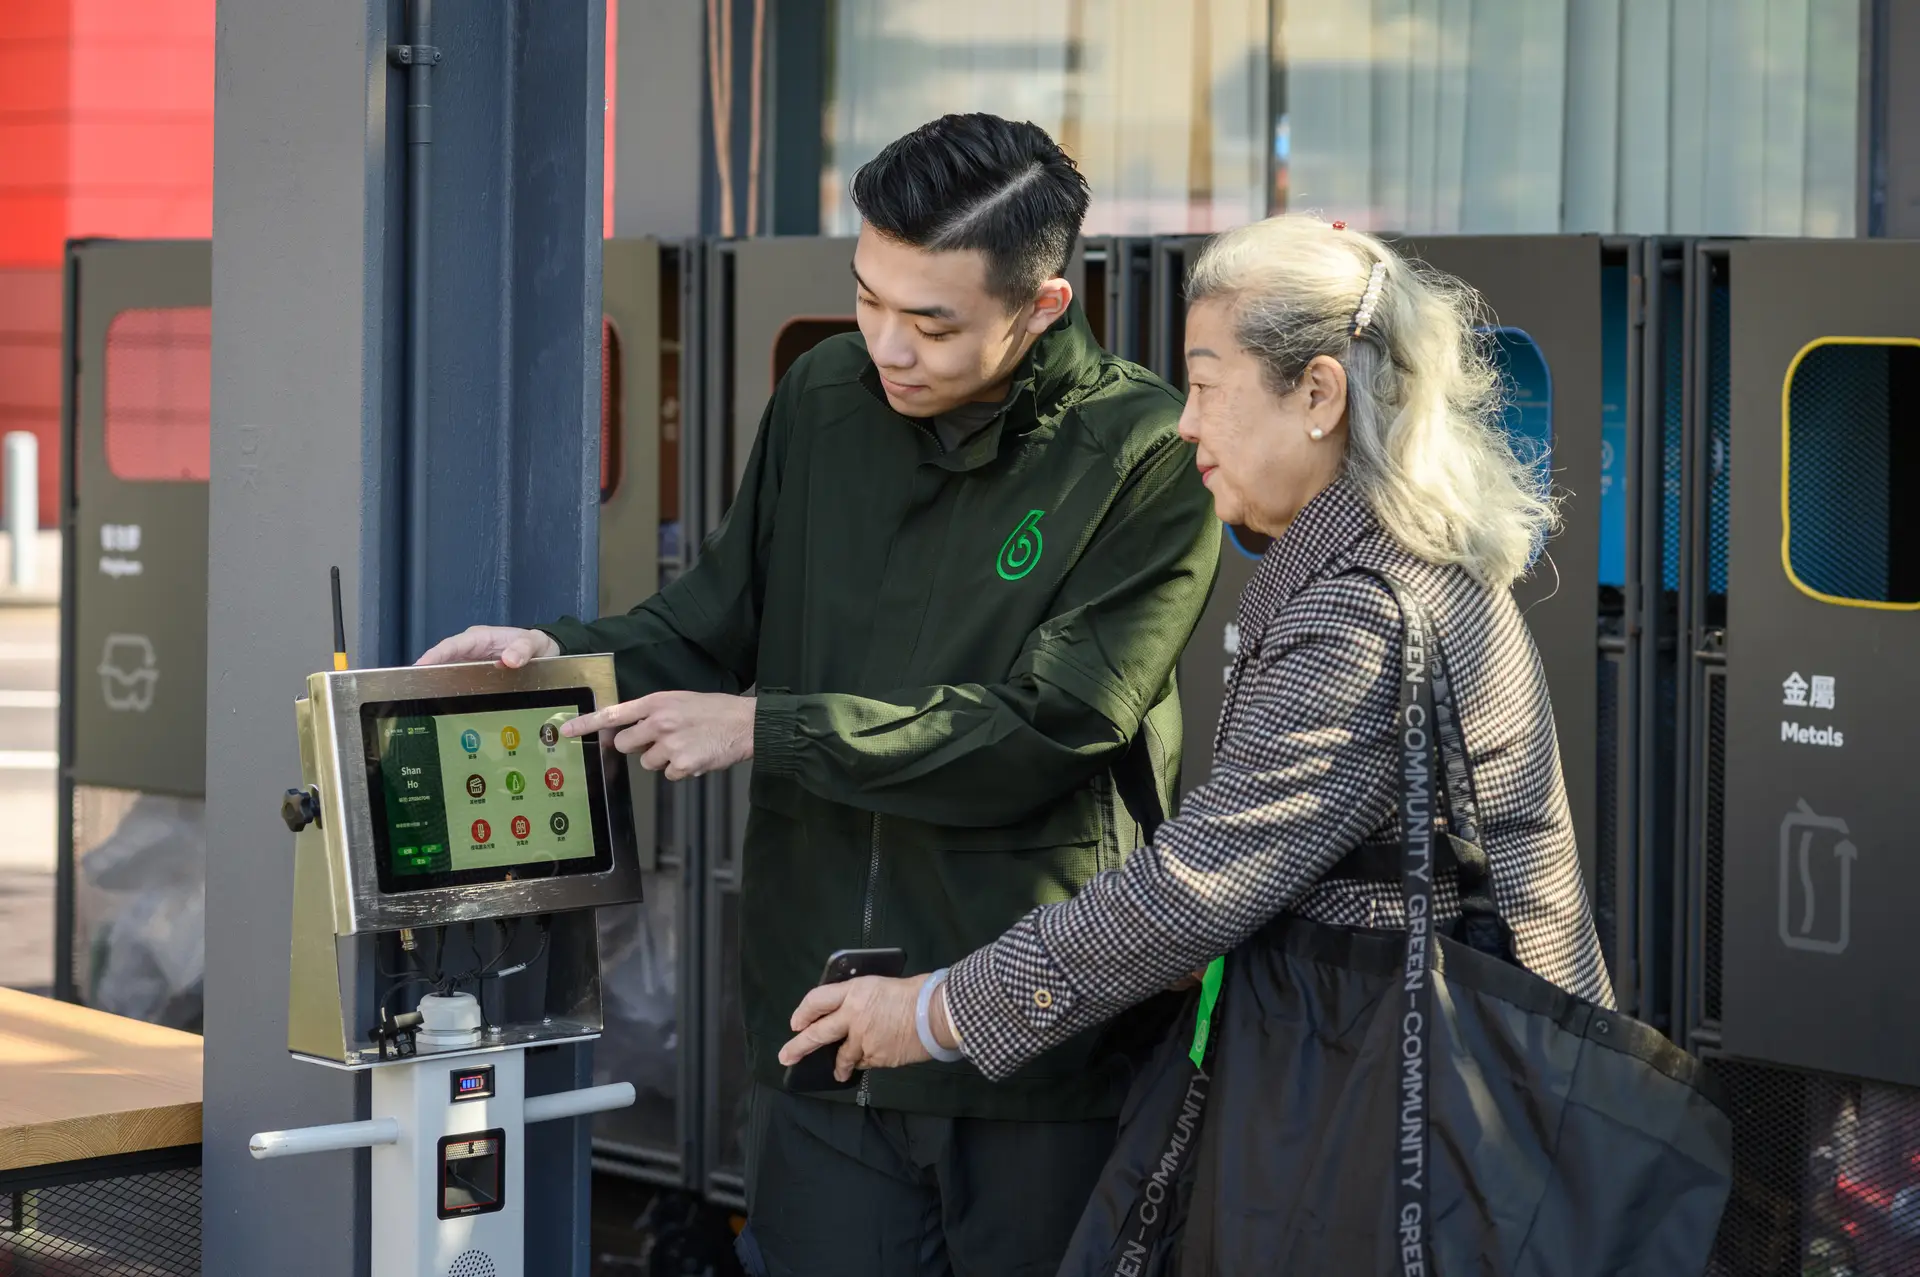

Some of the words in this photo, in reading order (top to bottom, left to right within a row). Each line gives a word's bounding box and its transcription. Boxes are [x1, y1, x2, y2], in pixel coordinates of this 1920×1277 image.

[1782, 670, 1836, 710] 金屬
[1781, 720, 1844, 748] Metals
[401, 766, 421, 776] Shan
[407, 780, 419, 789] Ho
[1400, 893, 1428, 1190] GREEN-COMMUNITY
[1114, 1068, 1211, 1277] EN-COMMUNITY
